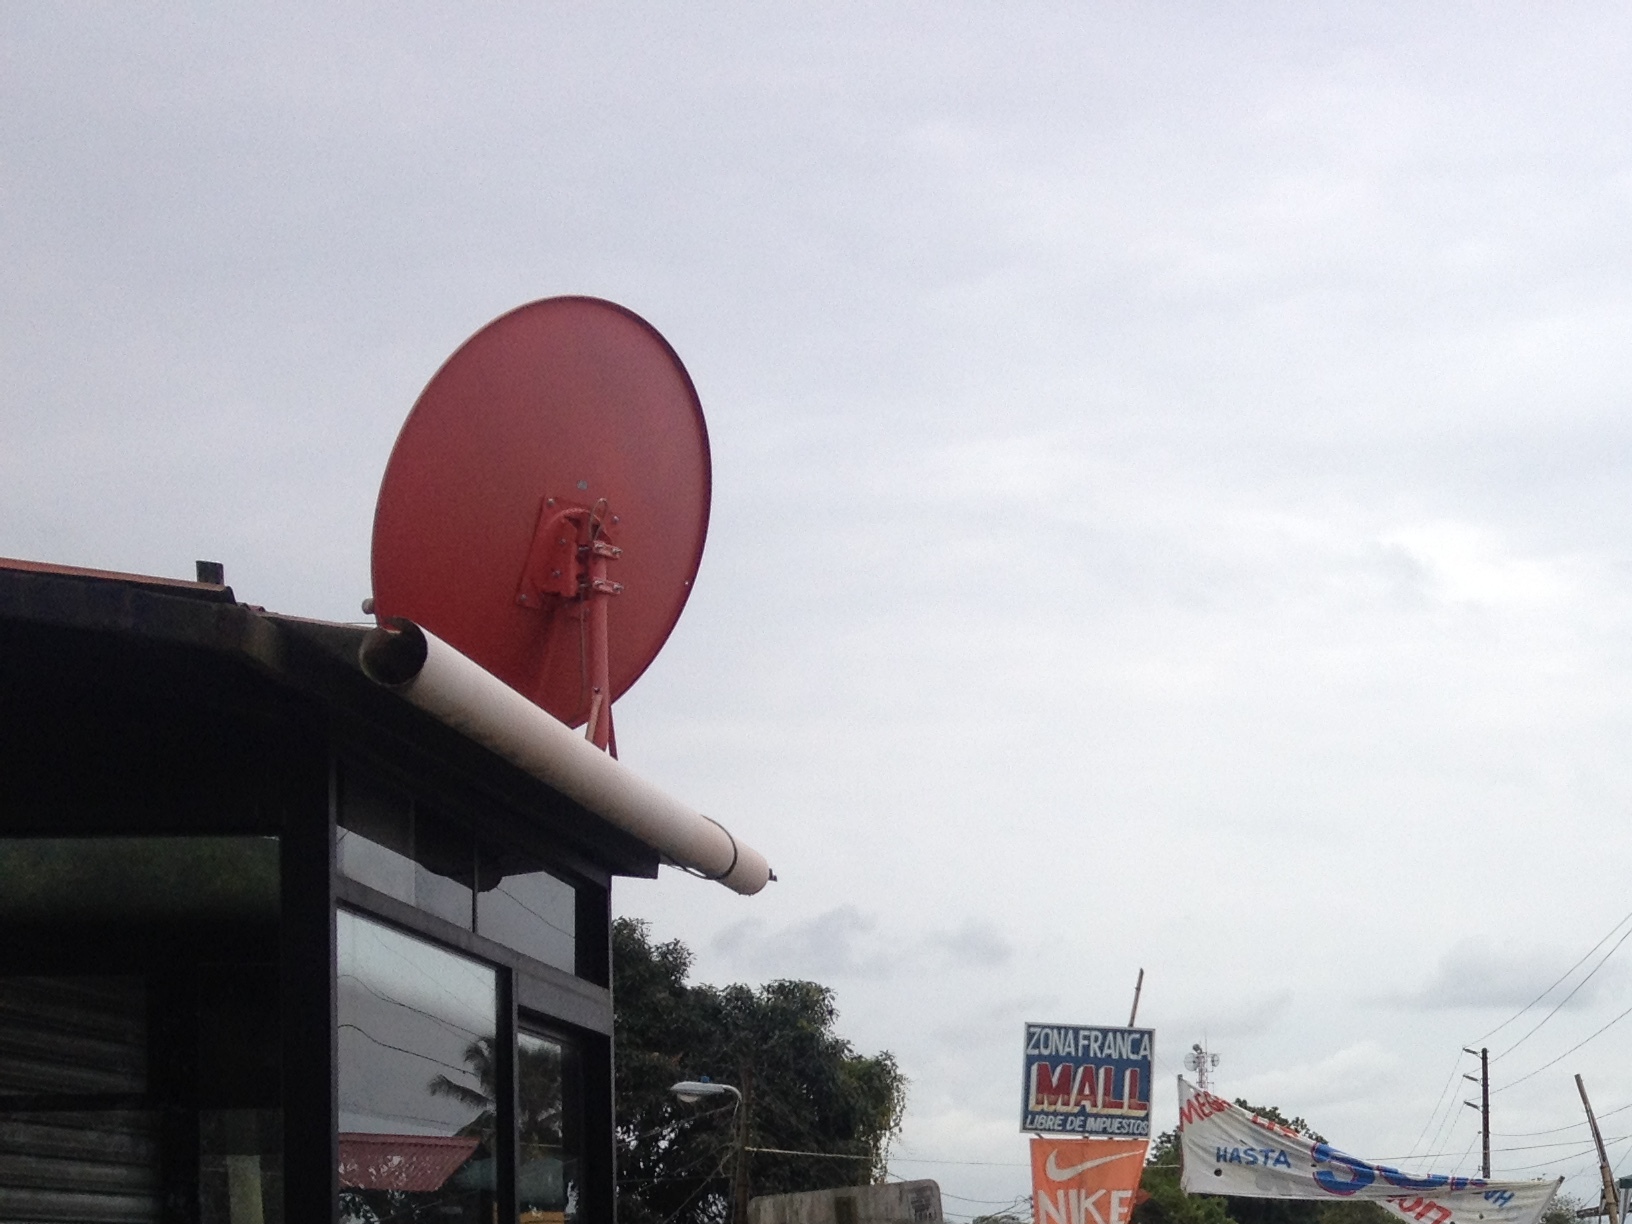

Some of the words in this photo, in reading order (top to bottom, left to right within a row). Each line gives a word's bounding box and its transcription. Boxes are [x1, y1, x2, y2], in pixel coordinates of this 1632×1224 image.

[1026, 1027, 1076, 1056] ZONA
[1078, 1029, 1151, 1060] FRANCA
[1029, 1061, 1149, 1117] MALL
[1026, 1114, 1064, 1129] LIBRE
[1066, 1116, 1083, 1131] DE
[1085, 1116, 1149, 1134] IMPUESTOS
[1216, 1146, 1291, 1169] HASTA
